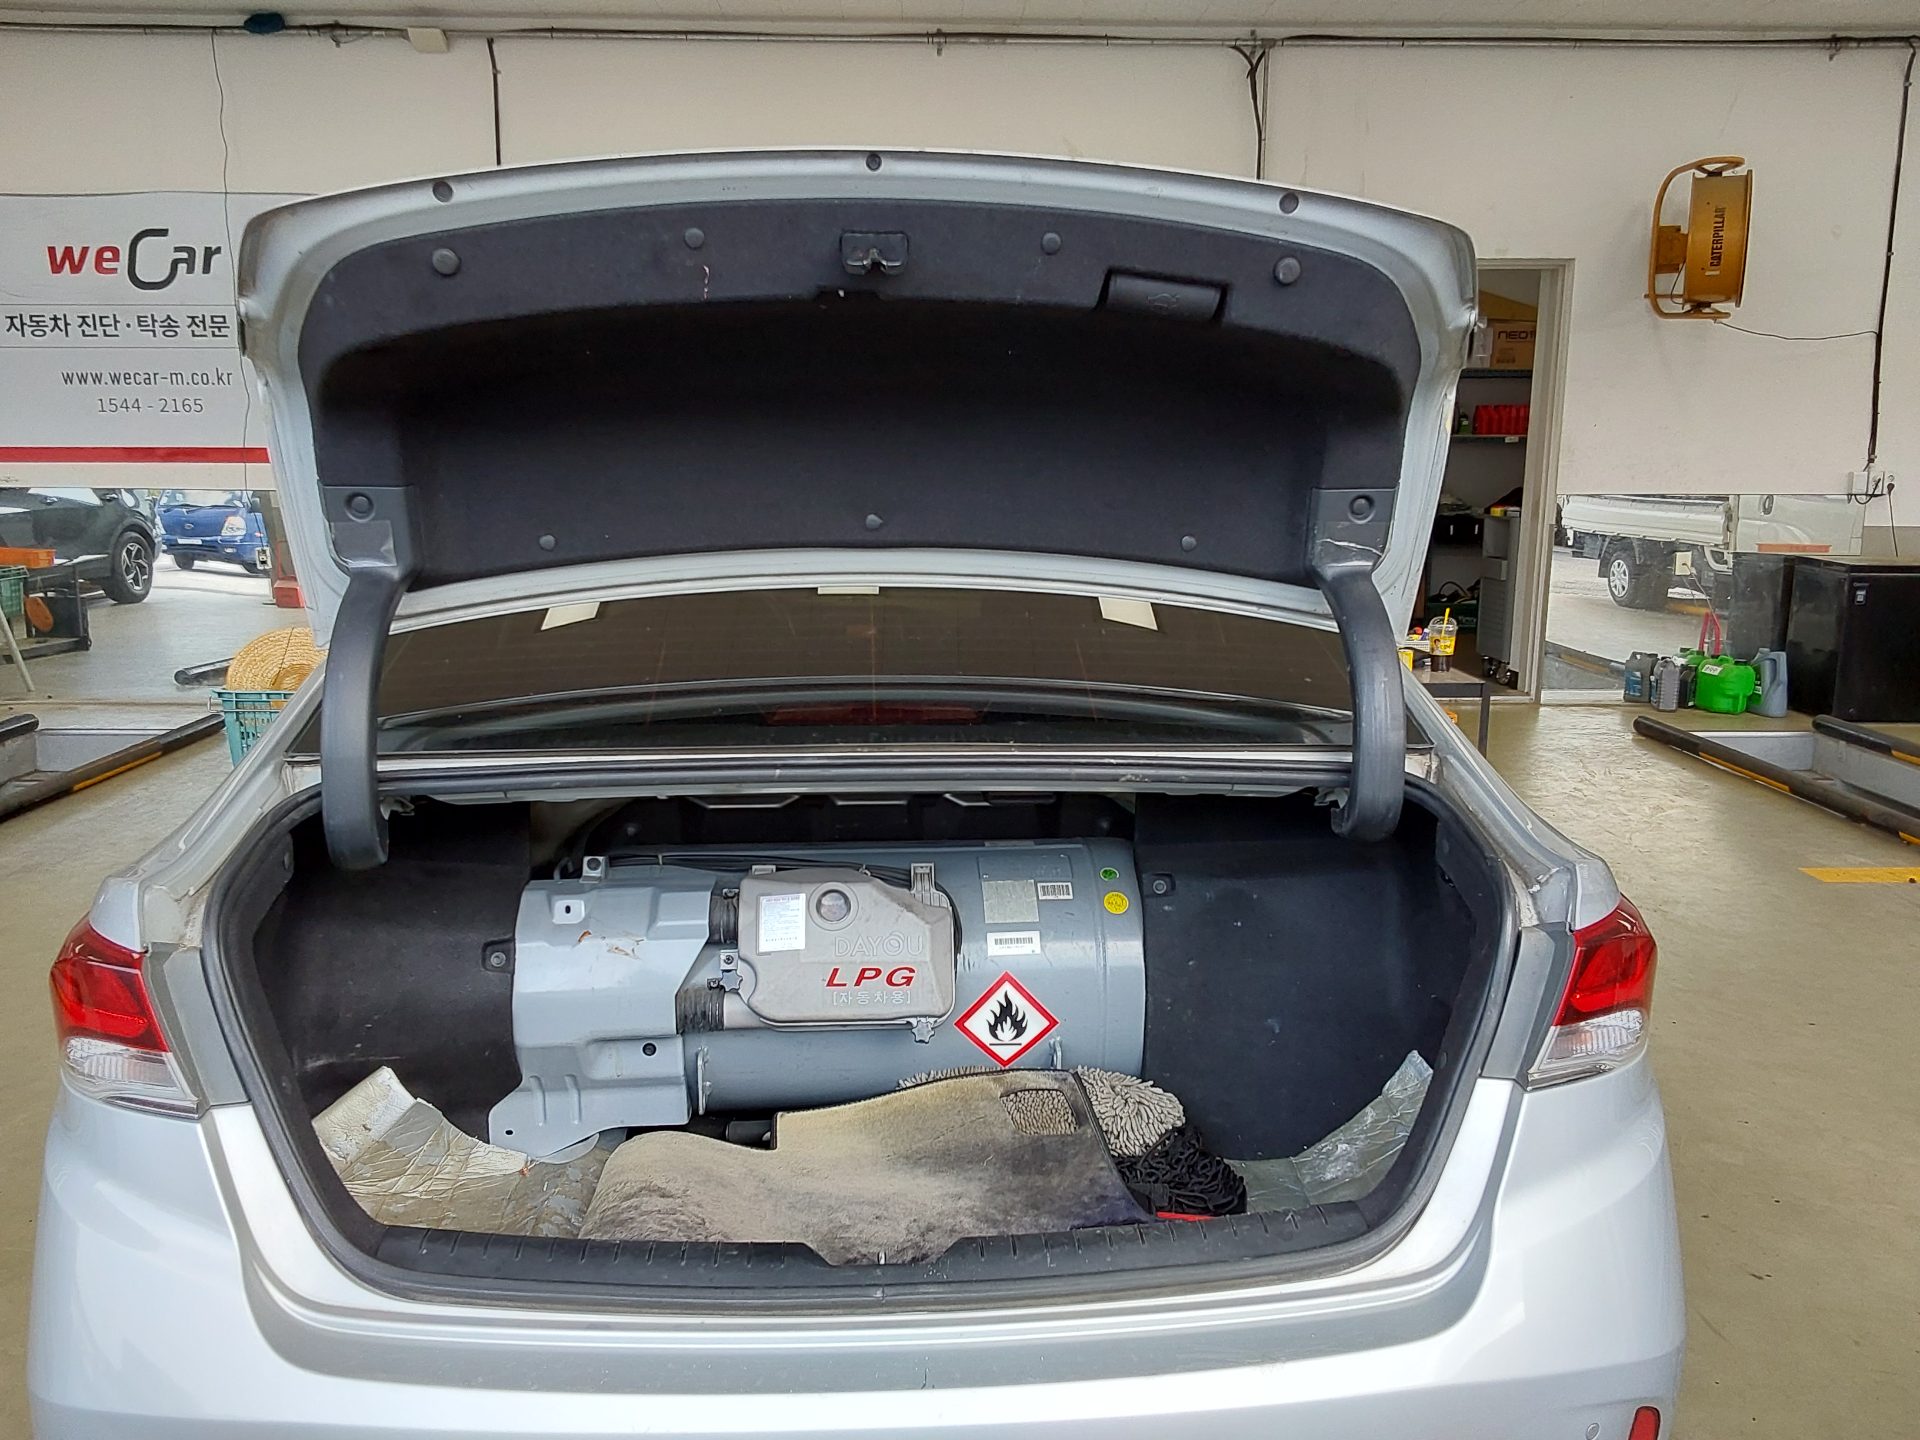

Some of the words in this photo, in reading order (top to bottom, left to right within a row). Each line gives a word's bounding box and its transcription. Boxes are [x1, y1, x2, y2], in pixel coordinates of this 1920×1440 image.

[1710, 207, 1726, 267] CATERPILLAR
[5, 313, 71, 338] 자동차
[187, 313, 230, 338] 전문
[61, 367, 233, 386] www.wecar-m.co.kr
[834, 930, 923, 957] DAYOU
[825, 966, 916, 988] LPG
